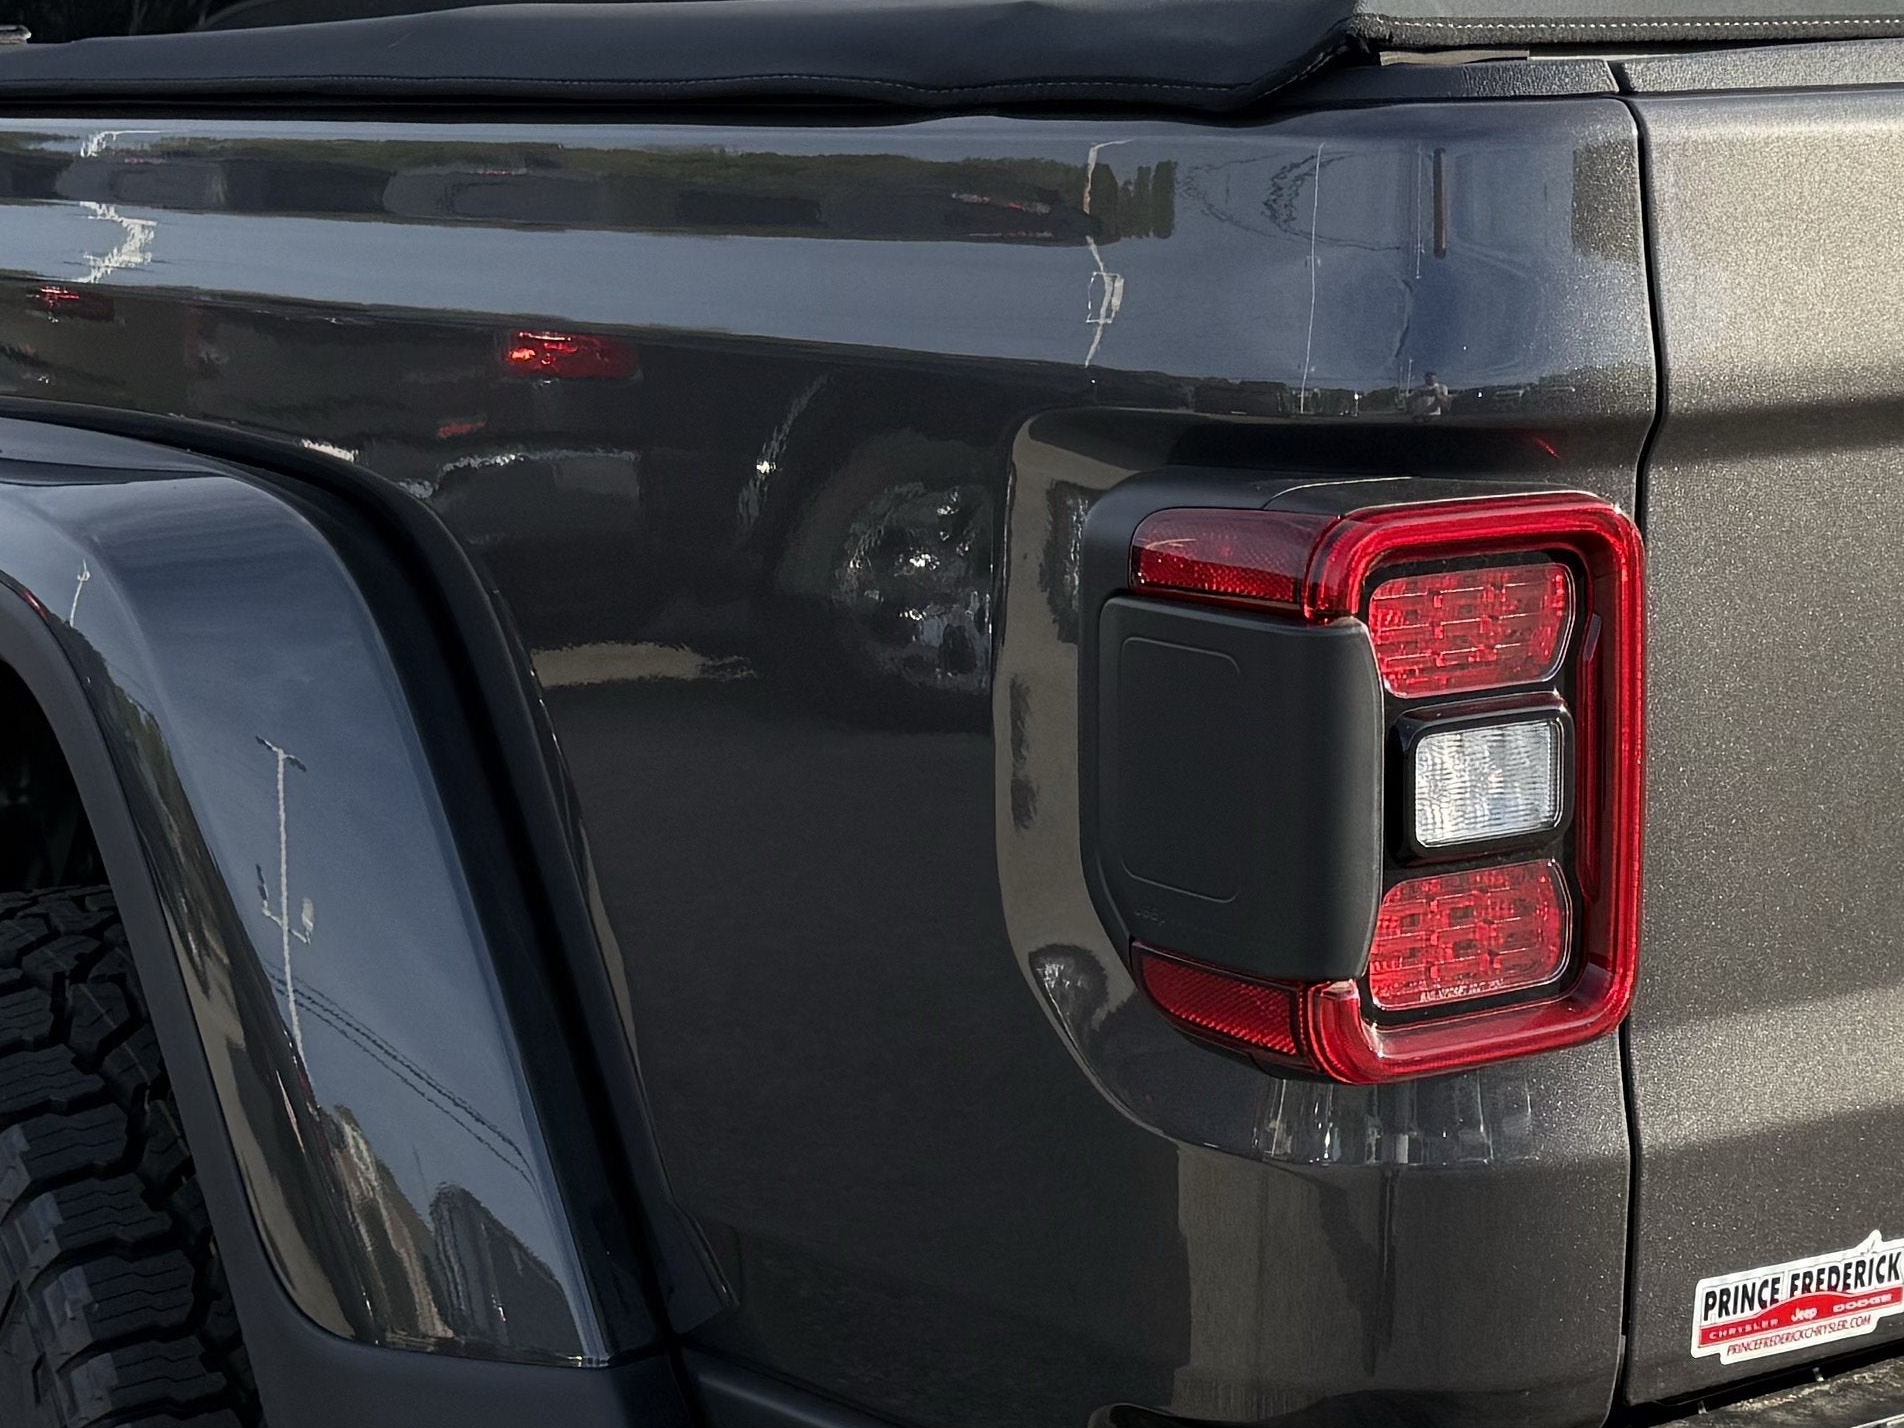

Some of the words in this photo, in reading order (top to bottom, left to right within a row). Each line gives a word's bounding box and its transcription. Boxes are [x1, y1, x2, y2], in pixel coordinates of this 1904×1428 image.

[1703, 1276, 1781, 1322] PRINCE
[1789, 1251, 1902, 1299] FREDERICK
[1709, 1318, 1779, 1340] CHRYSLER
[1791, 1307, 1817, 1322] Jeep
[1833, 1293, 1892, 1313] DODGE
